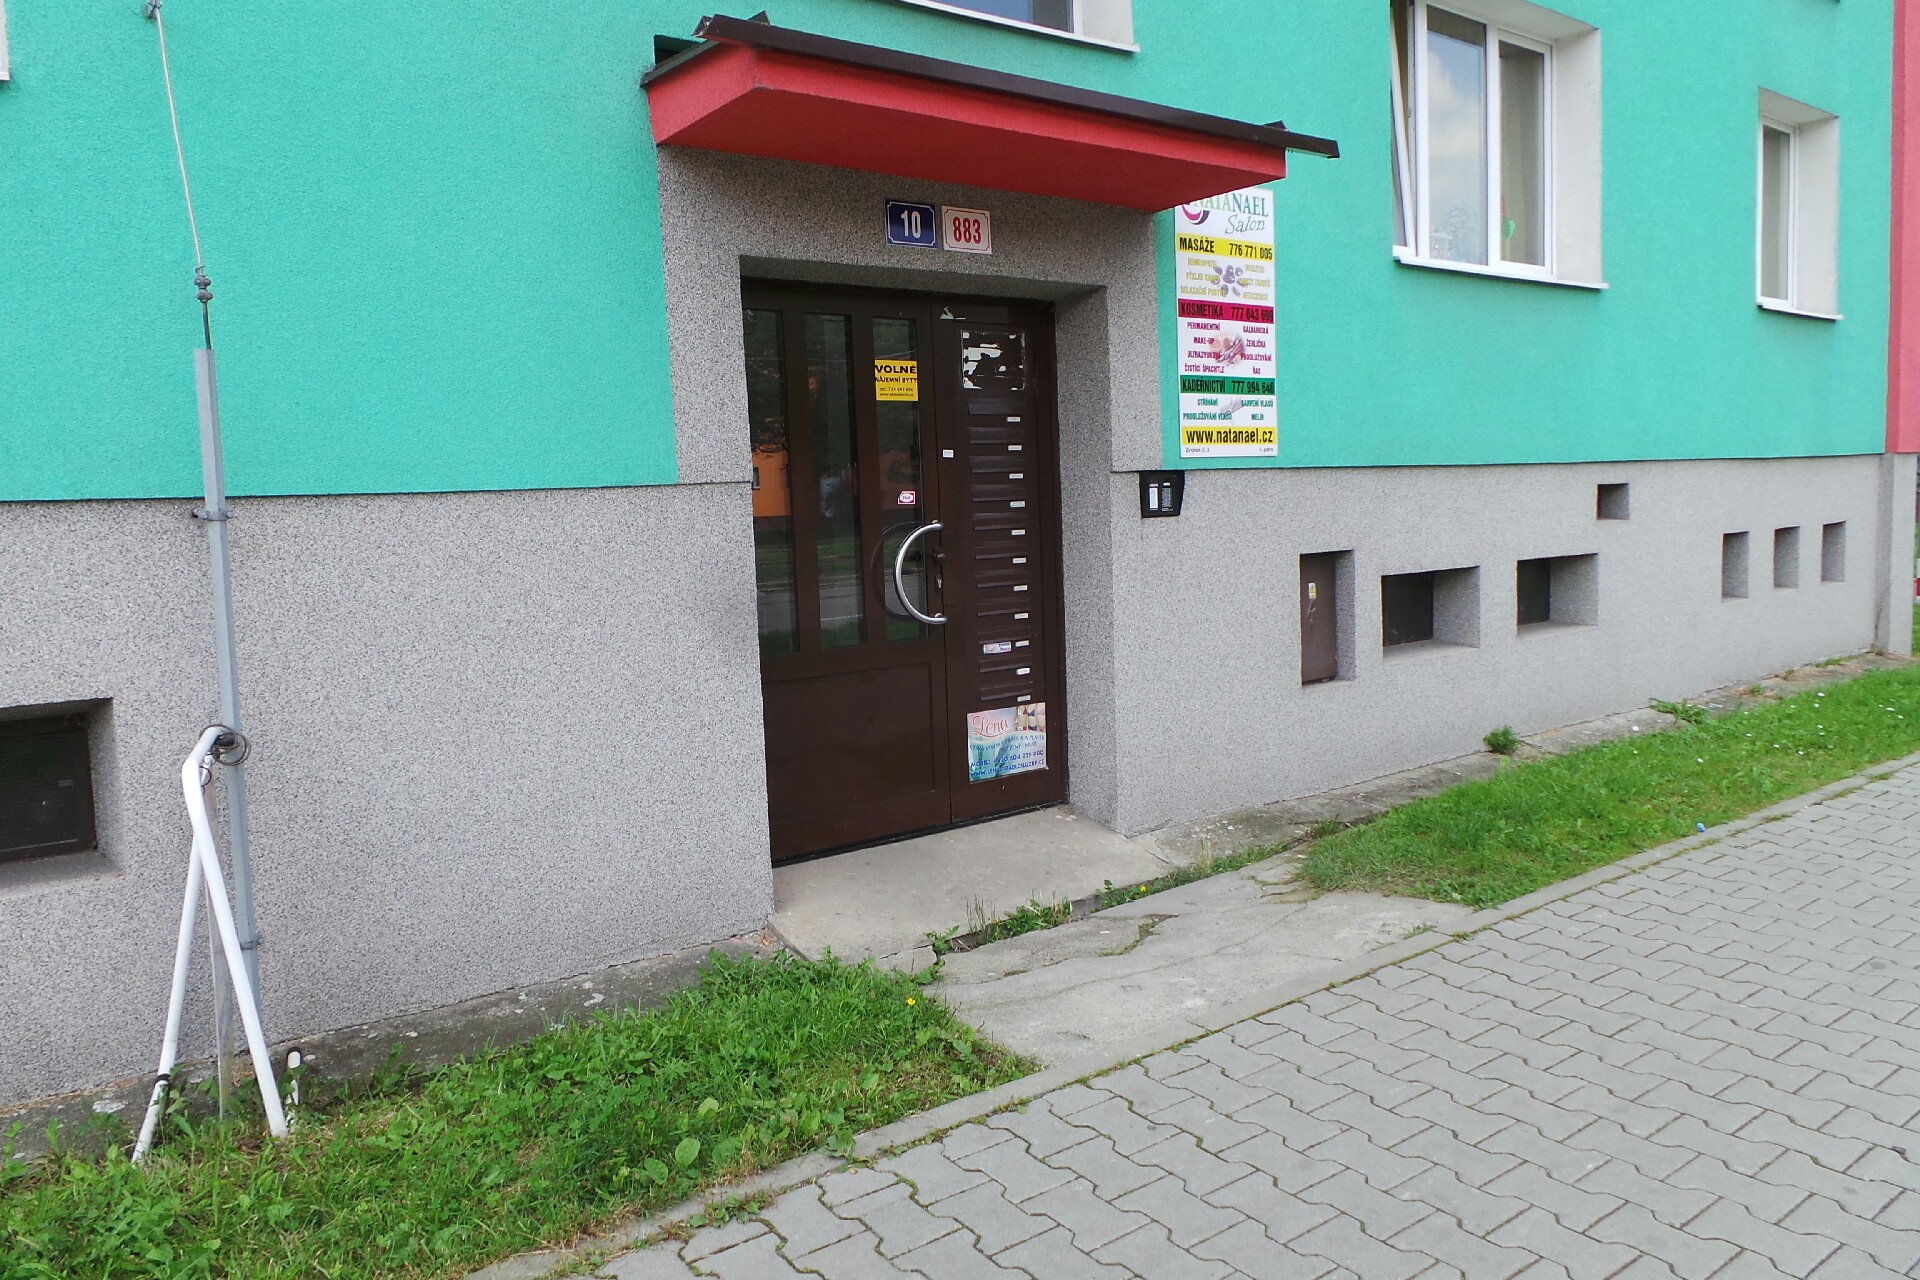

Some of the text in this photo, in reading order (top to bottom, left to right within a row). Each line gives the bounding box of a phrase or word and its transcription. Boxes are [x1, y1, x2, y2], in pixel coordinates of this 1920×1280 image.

[901, 210, 921, 239] 10
[952, 216, 982, 244] 883
[1224, 213, 1265, 235] Salon
[1179, 236, 1215, 254] MASÁŽE
[1229, 243, 1243, 256] 776
[1245, 245, 1257, 258] 771
[1181, 302, 1224, 318] KOSMETIKA
[1230, 306, 1244, 319] 777
[874, 364, 917, 374] VOLNÉ
[874, 375, 901, 383] NÁJEMNÍ
[1182, 377, 1226, 392] KADEŘNICTVÍ
[1231, 380, 1245, 393] 777
[1185, 427, 1274, 444] www.natanael.cz
[971, 714, 1009, 737] Lena
